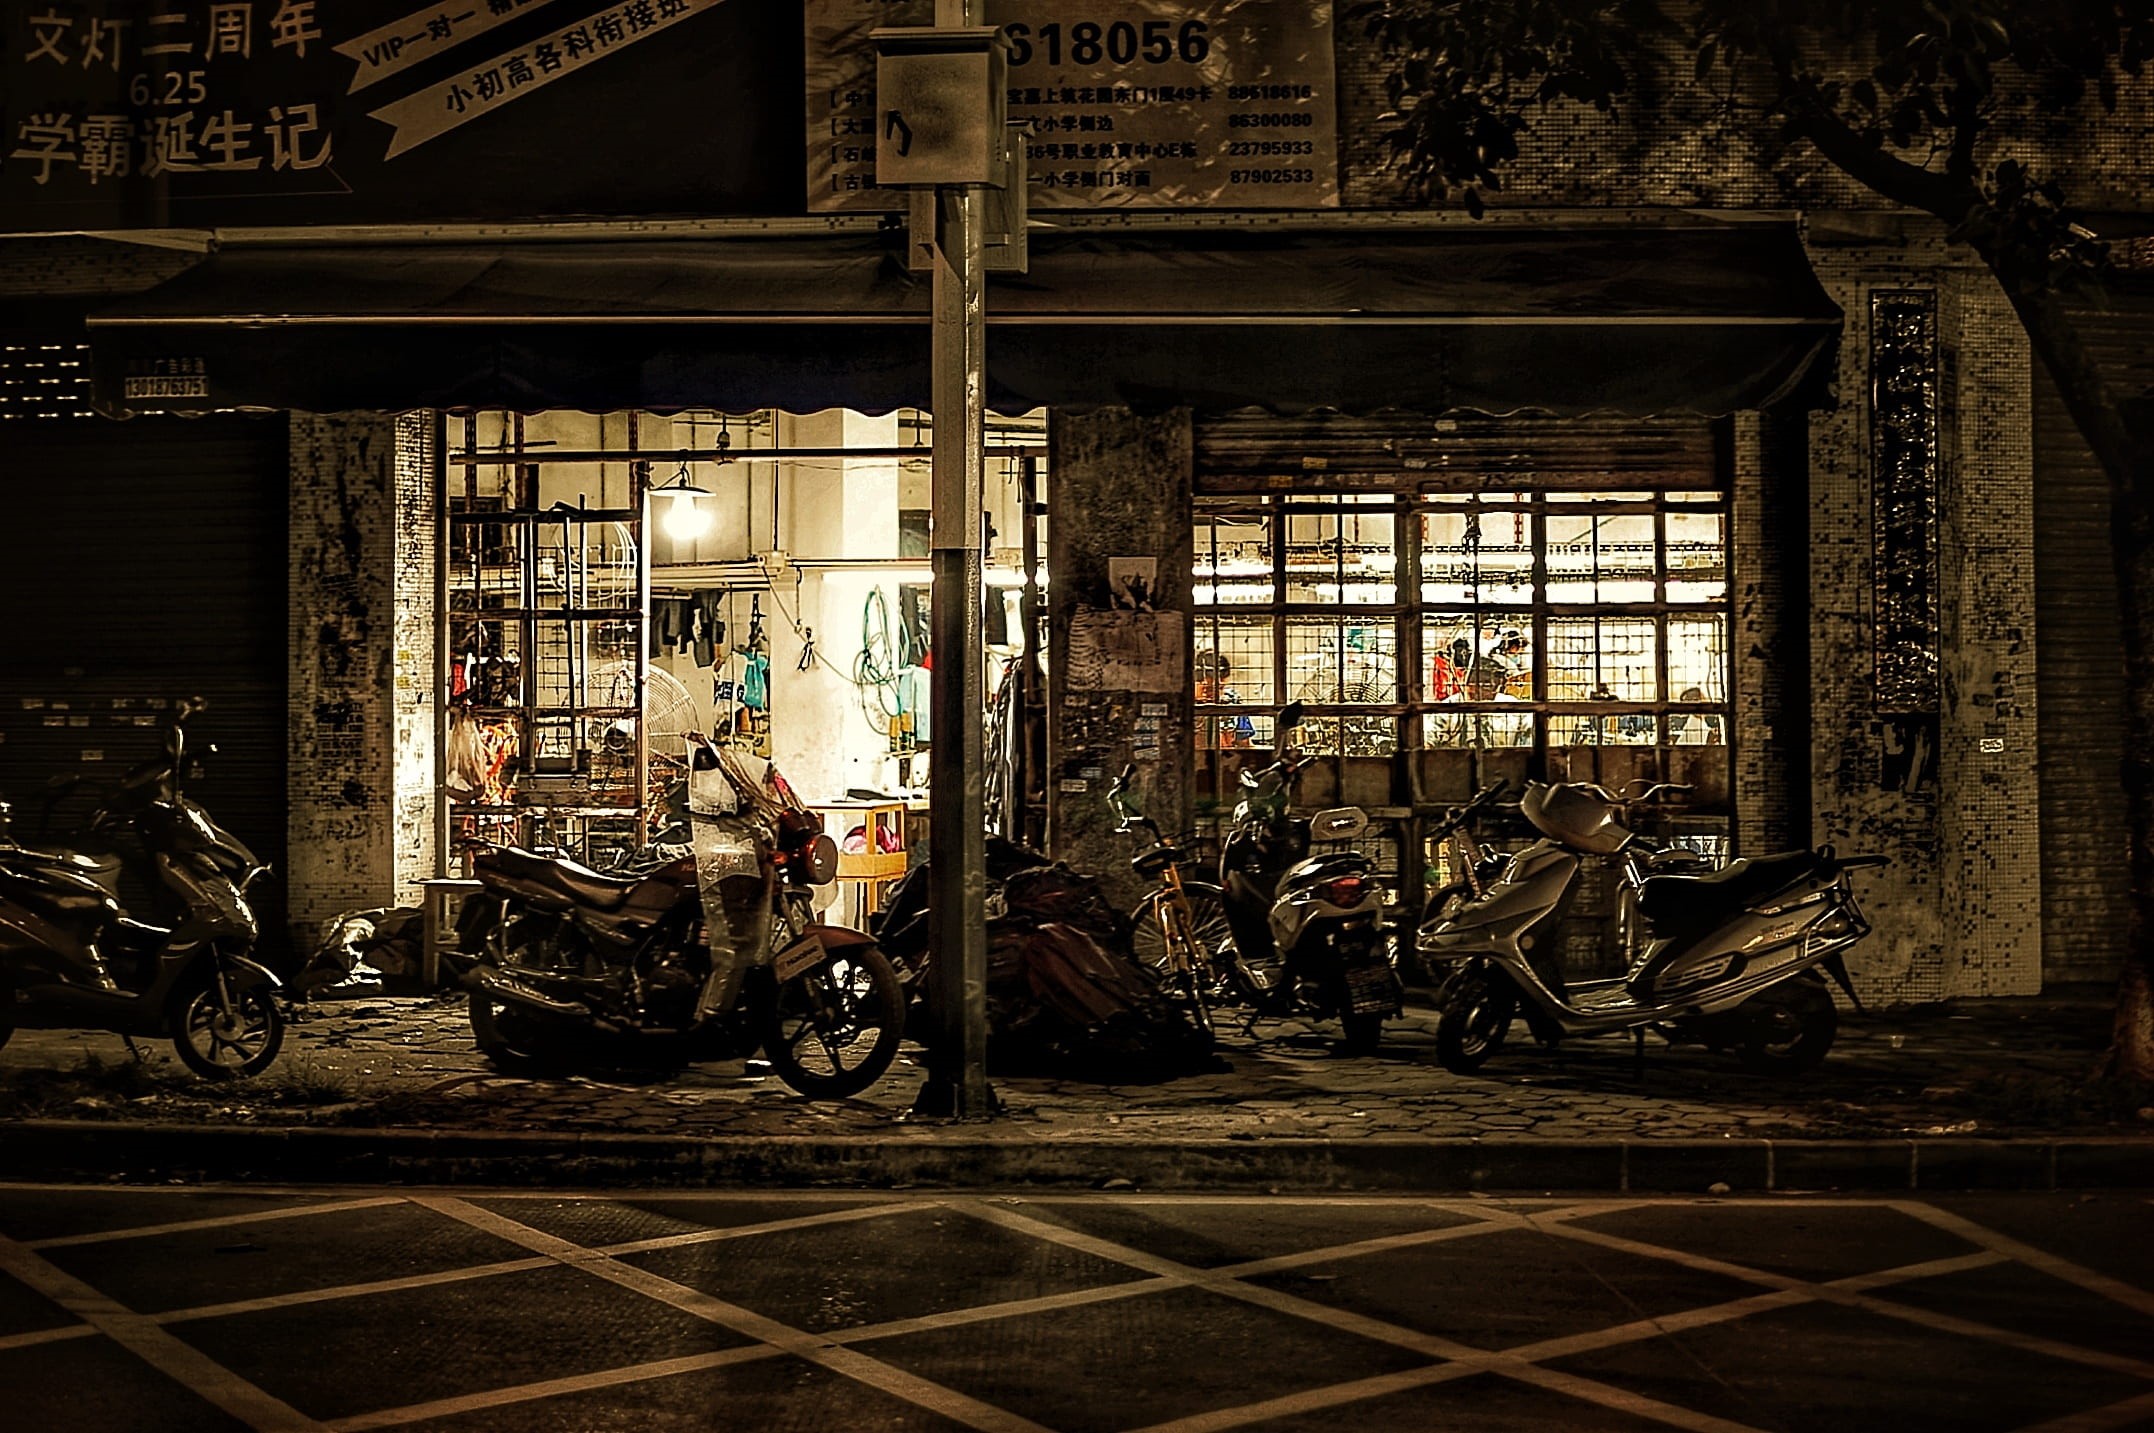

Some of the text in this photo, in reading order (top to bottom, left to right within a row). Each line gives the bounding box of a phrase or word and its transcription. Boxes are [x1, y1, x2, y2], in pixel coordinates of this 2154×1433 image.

[24, 0, 323, 73] 文灯二周年
[363, 10, 476, 67] VIP一对一
[446, 0, 690, 113] 小初高各科衔接班
[129, 69, 208, 107] 6.25
[1228, 85, 1312, 100] 88618616
[1229, 113, 1312, 128] 86300080
[9, 102, 334, 186] 学霸诞生记
[1229, 141, 1313, 156] 23795933
[1230, 169, 1314, 184] 87902533
